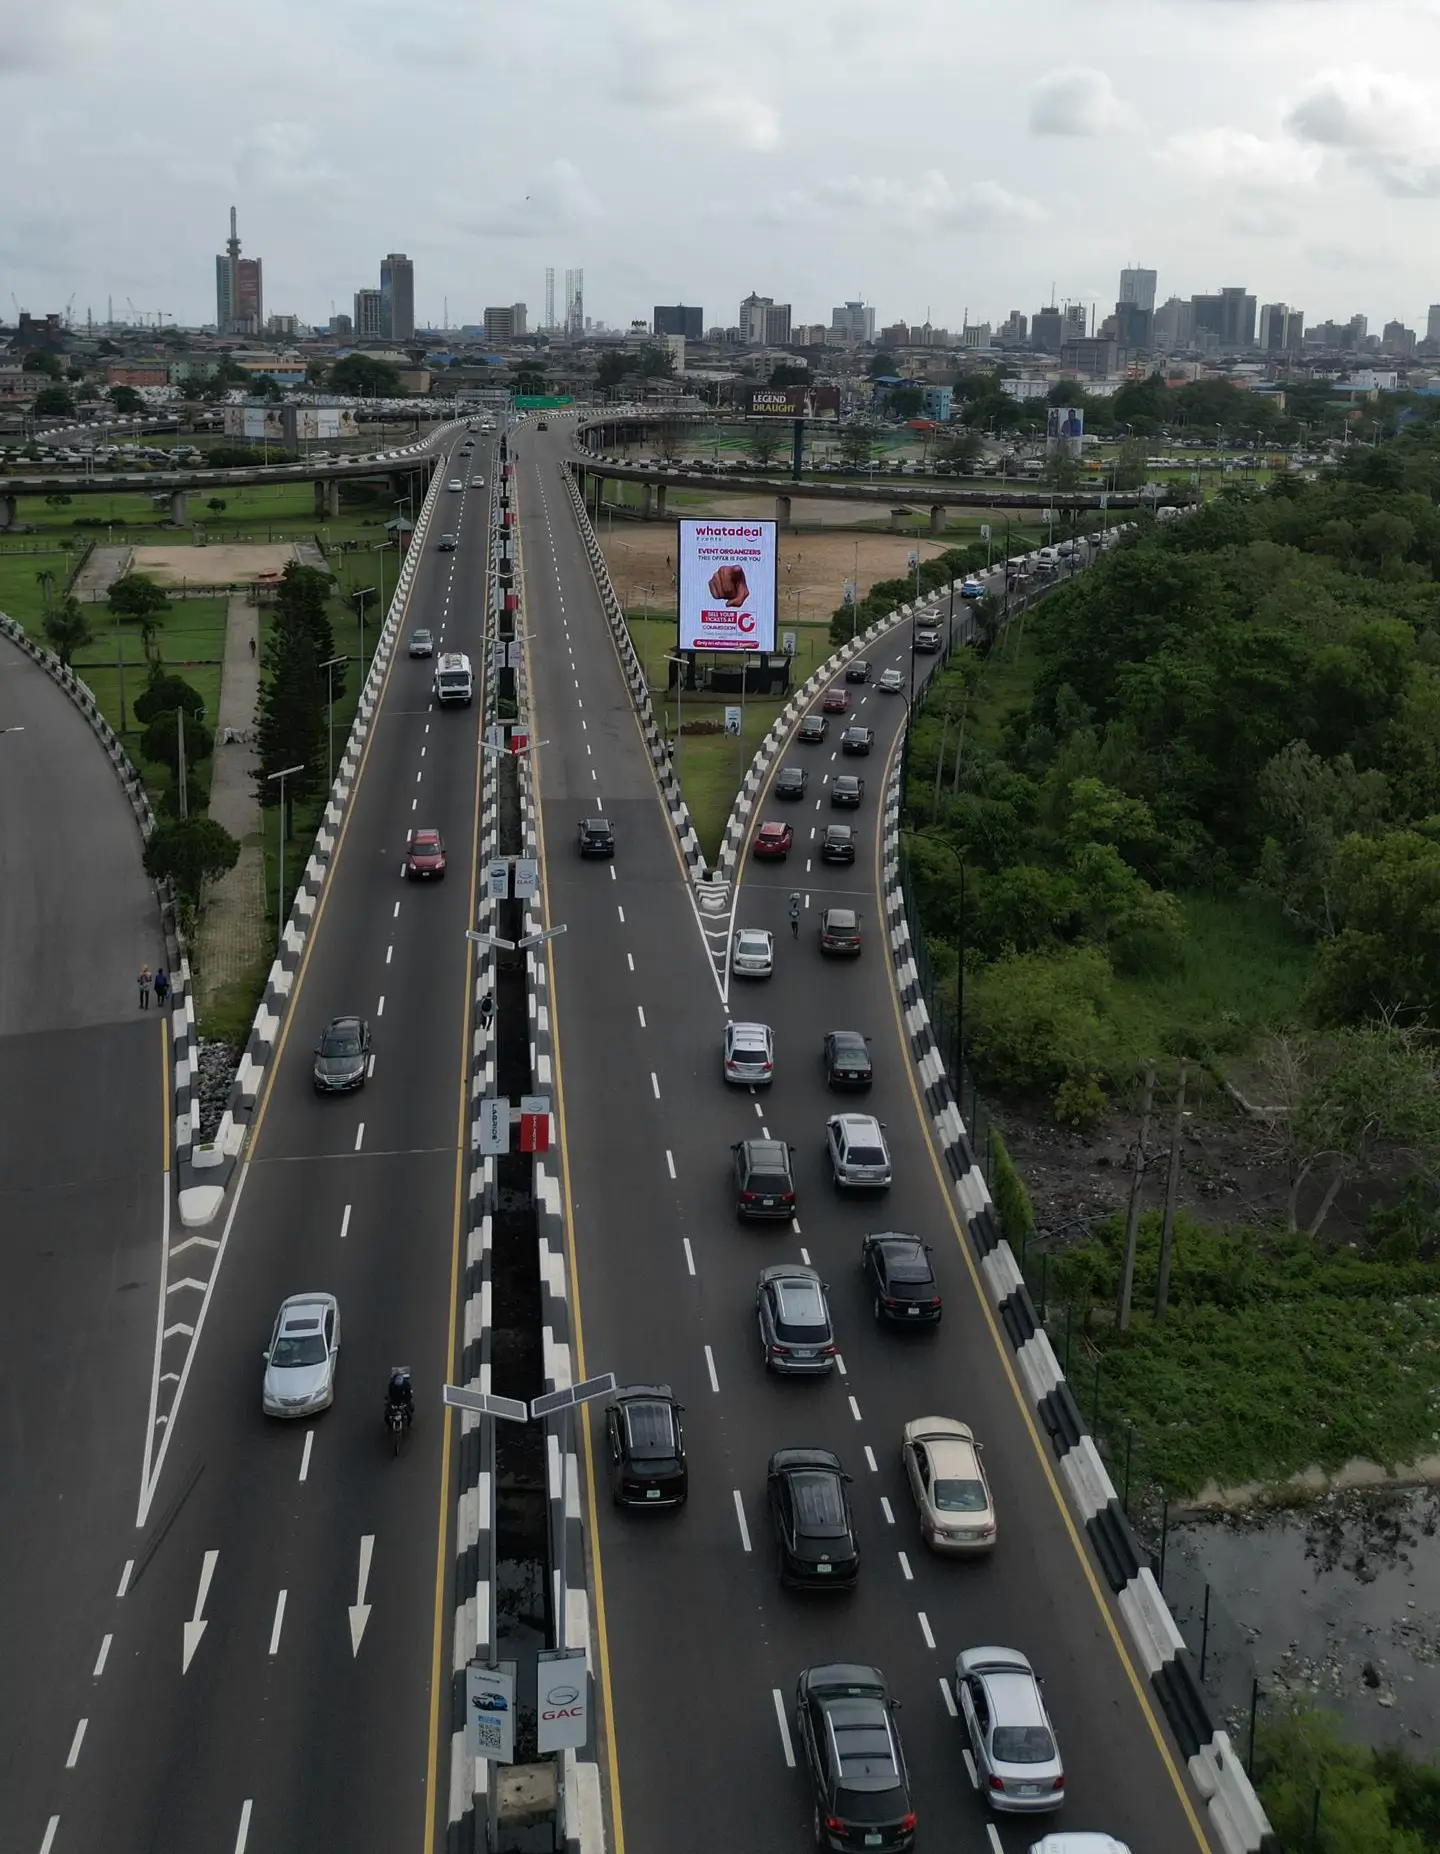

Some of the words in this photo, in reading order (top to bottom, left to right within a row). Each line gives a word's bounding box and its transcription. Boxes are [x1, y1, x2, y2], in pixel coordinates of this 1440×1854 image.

[753, 395, 786, 403] LEGEND
[753, 404, 795, 412] DRAUGHT
[696, 526, 762, 536] whatadeal
[541, 1706, 583, 1720] GAC
